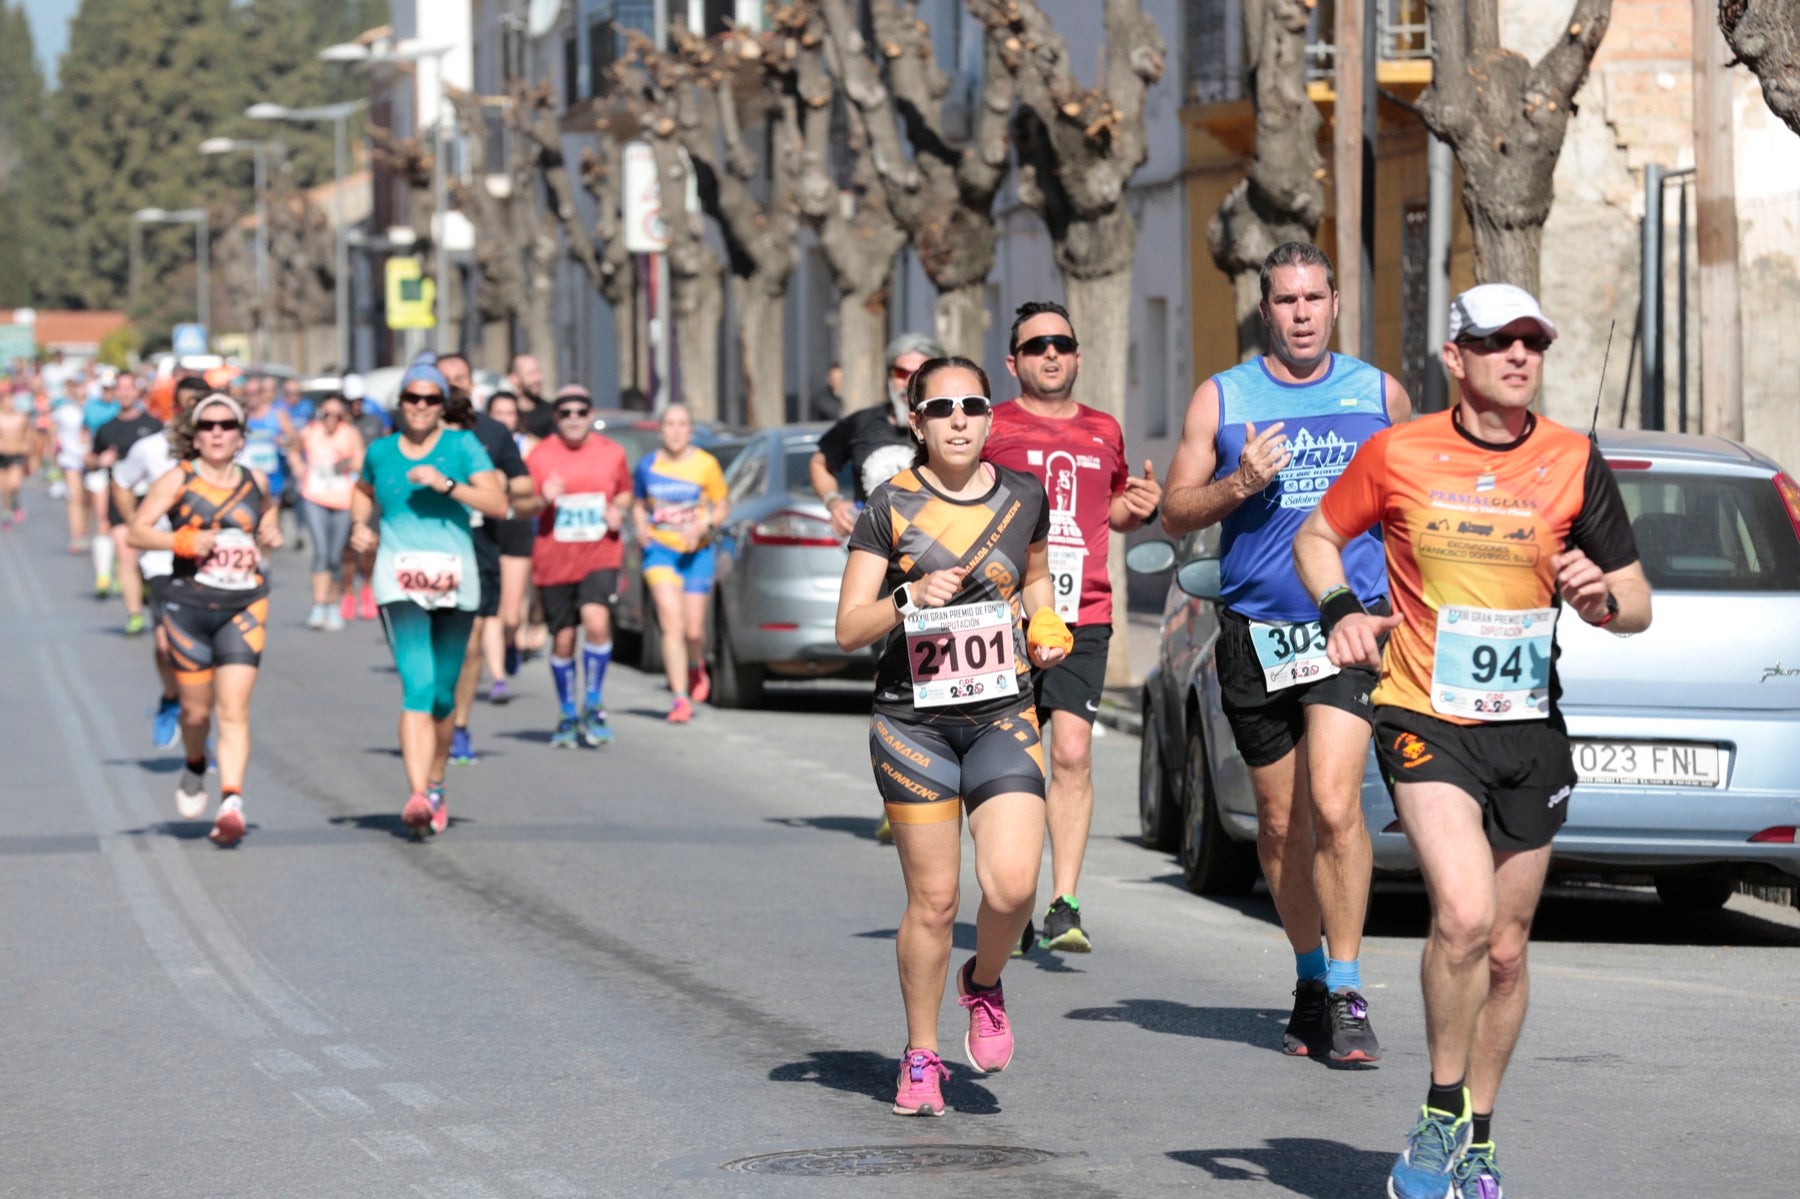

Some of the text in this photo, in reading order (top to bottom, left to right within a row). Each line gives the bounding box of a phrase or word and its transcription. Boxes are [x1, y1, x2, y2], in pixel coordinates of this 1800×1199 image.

[931, 609, 948, 621] GRAN
[950, 605, 974, 619] PREMIO
[975, 604, 983, 614] DE
[914, 630, 1006, 676] 2101
[1471, 645, 1523, 683] 94
[876, 721, 932, 769] GRANADA
[1570, 743, 1709, 777] 023 FNL
[880, 761, 940, 802] RUNNING
